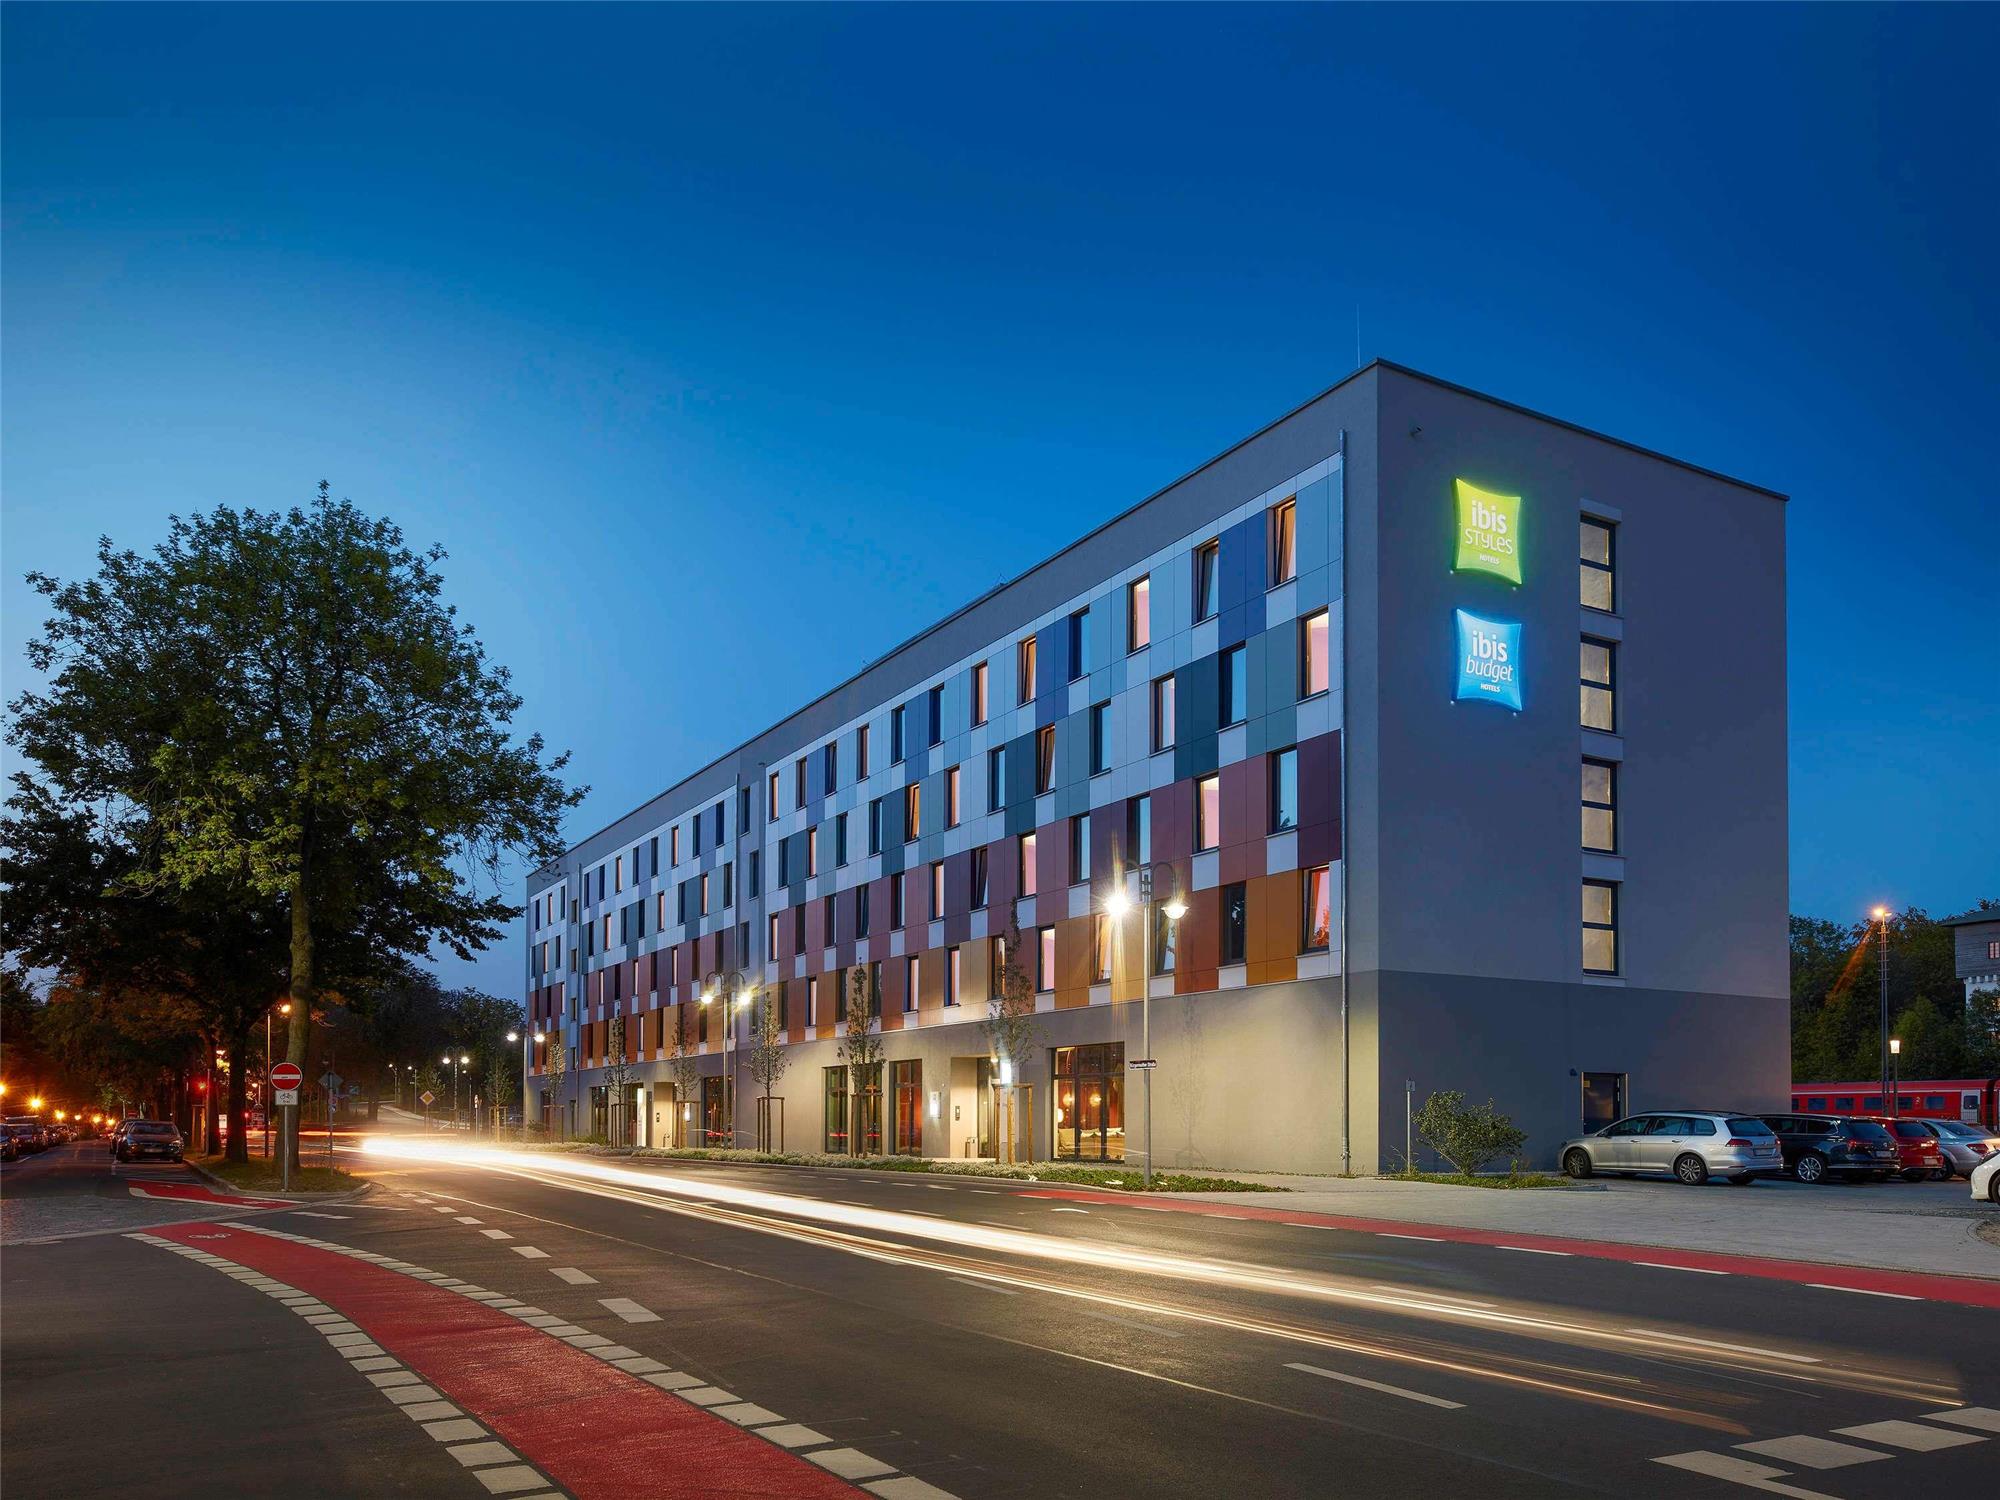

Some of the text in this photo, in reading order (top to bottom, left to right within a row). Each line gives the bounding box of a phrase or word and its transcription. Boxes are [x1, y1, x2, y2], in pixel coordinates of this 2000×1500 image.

[1471, 500, 1507, 534] ibis
[1479, 553, 1500, 565] HOTELS
[1472, 630, 1507, 662] ibis
[1466, 655, 1513, 683] budget
[1480, 682, 1501, 693] HOTELS
